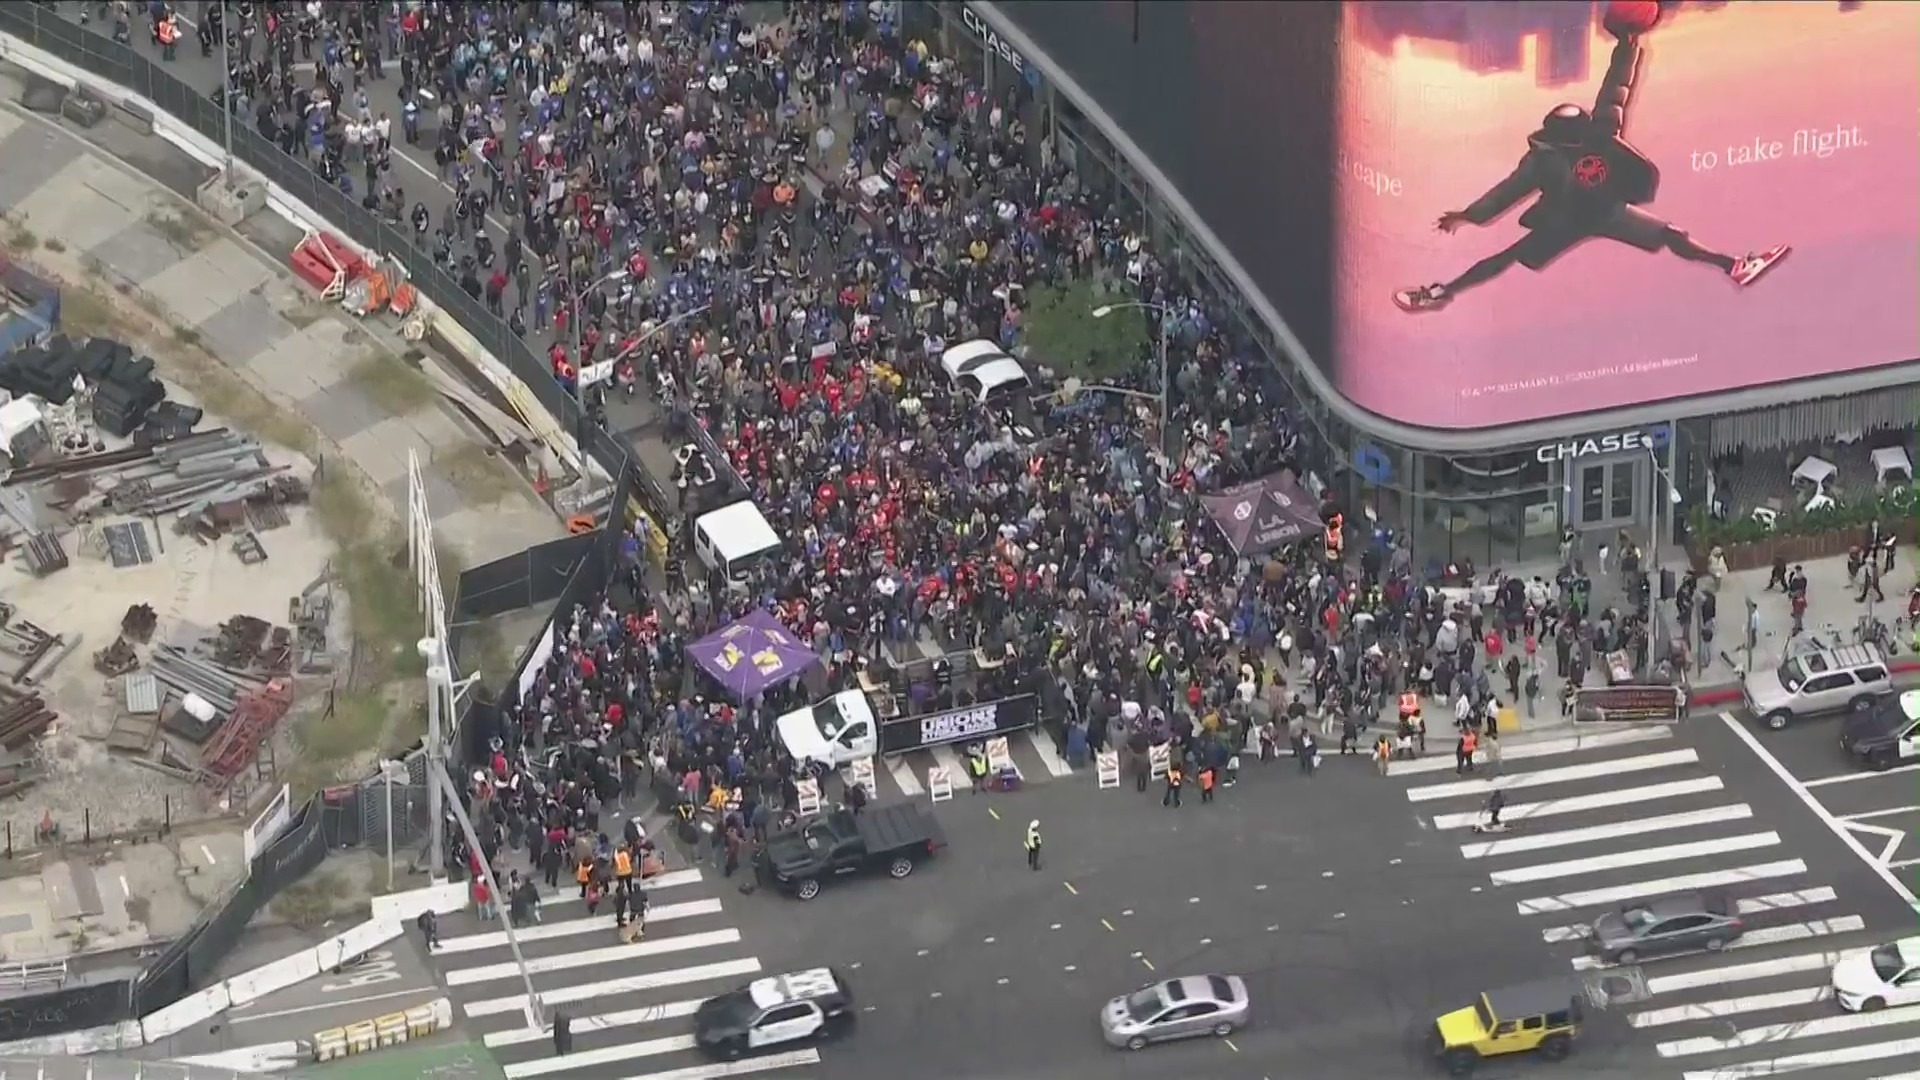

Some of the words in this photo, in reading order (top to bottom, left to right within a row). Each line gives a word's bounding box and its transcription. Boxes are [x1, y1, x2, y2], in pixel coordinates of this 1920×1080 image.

[963, 7, 1024, 74] CHASE
[1690, 149, 1718, 172] to
[1727, 136, 1783, 166] take
[1792, 123, 1869, 159] flight.
[1353, 161, 1403, 197] cape
[1537, 430, 1641, 463] CHASE
